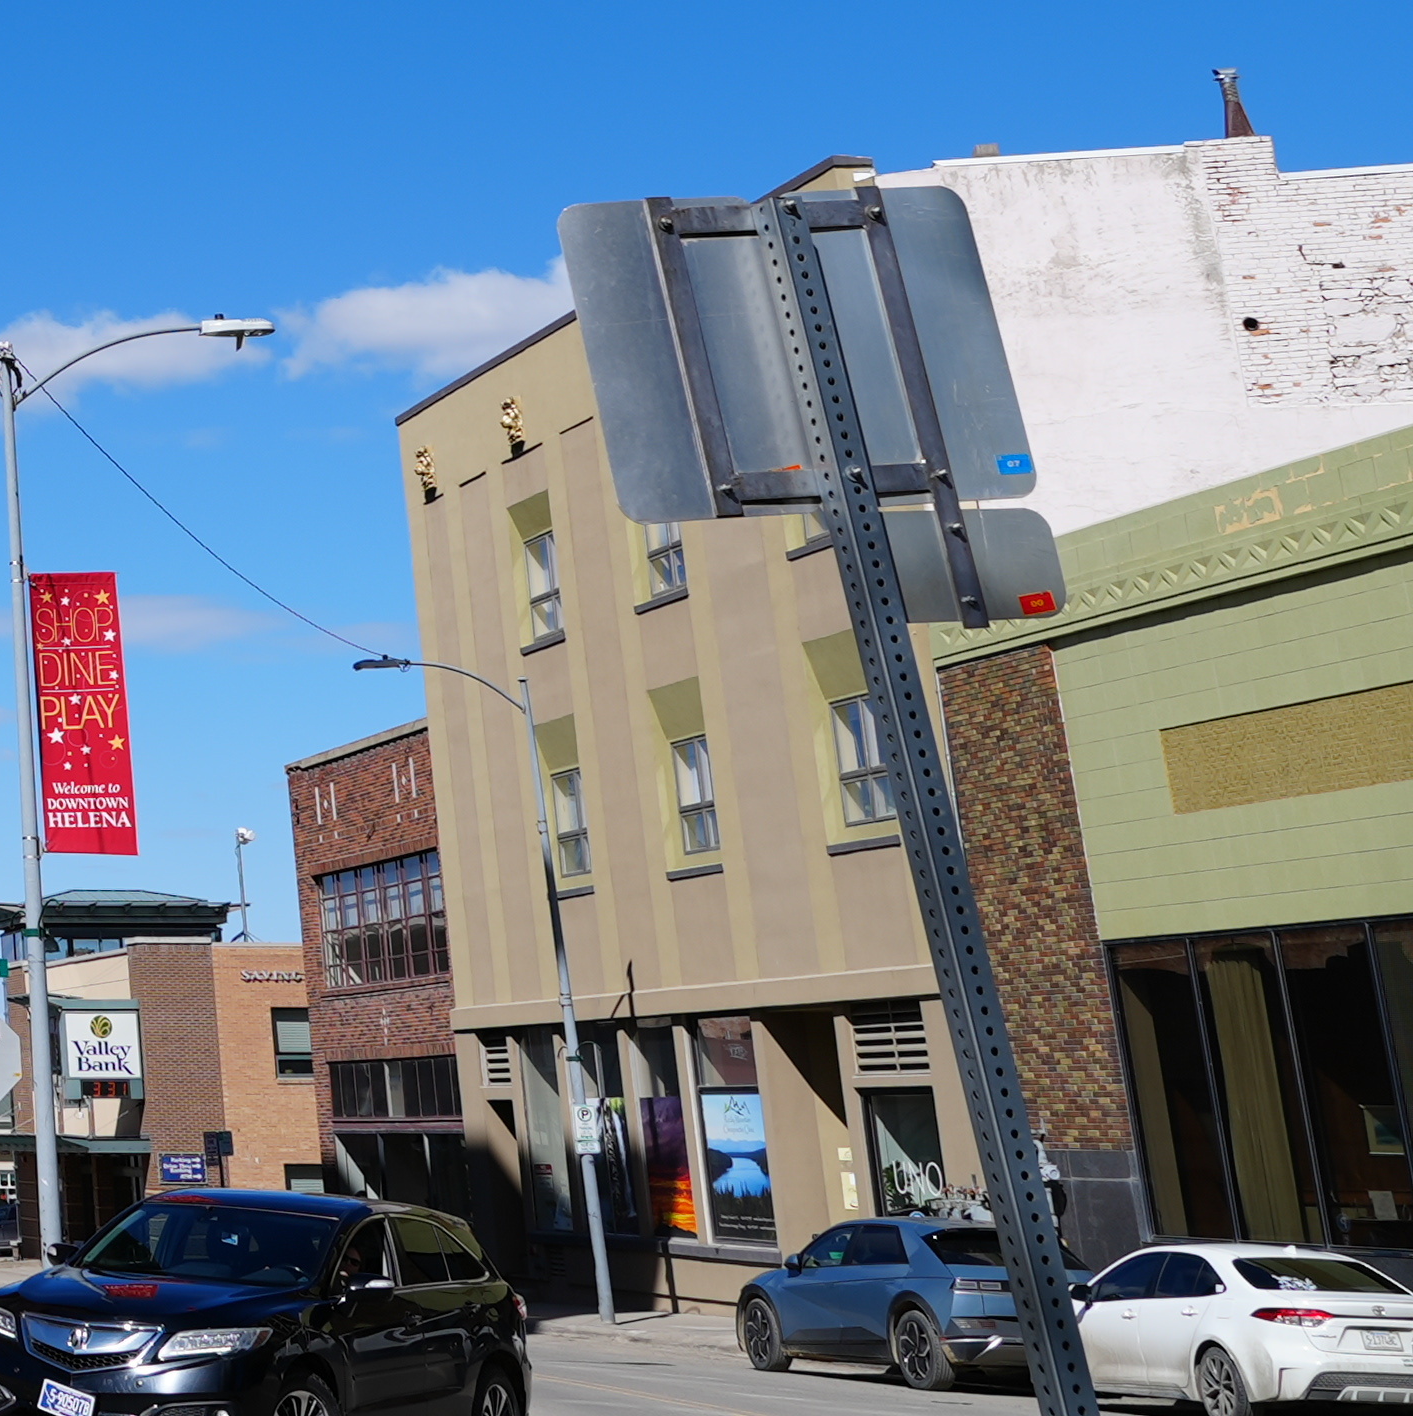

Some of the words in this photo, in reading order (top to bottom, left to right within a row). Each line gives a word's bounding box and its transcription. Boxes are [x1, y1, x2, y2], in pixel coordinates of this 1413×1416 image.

[36, 607, 113, 643] SHOP
[39, 651, 116, 686] DINE
[40, 694, 119, 730] PLAY
[52, 781, 105, 794] Welcome
[108, 783, 121, 793] to
[47, 797, 129, 810] DOWNTOWN
[47, 811, 132, 828] HELENA
[71, 1040, 131, 1060] Valley
[76, 1055, 135, 1075] Bank
[892, 1160, 943, 1196] UNO
